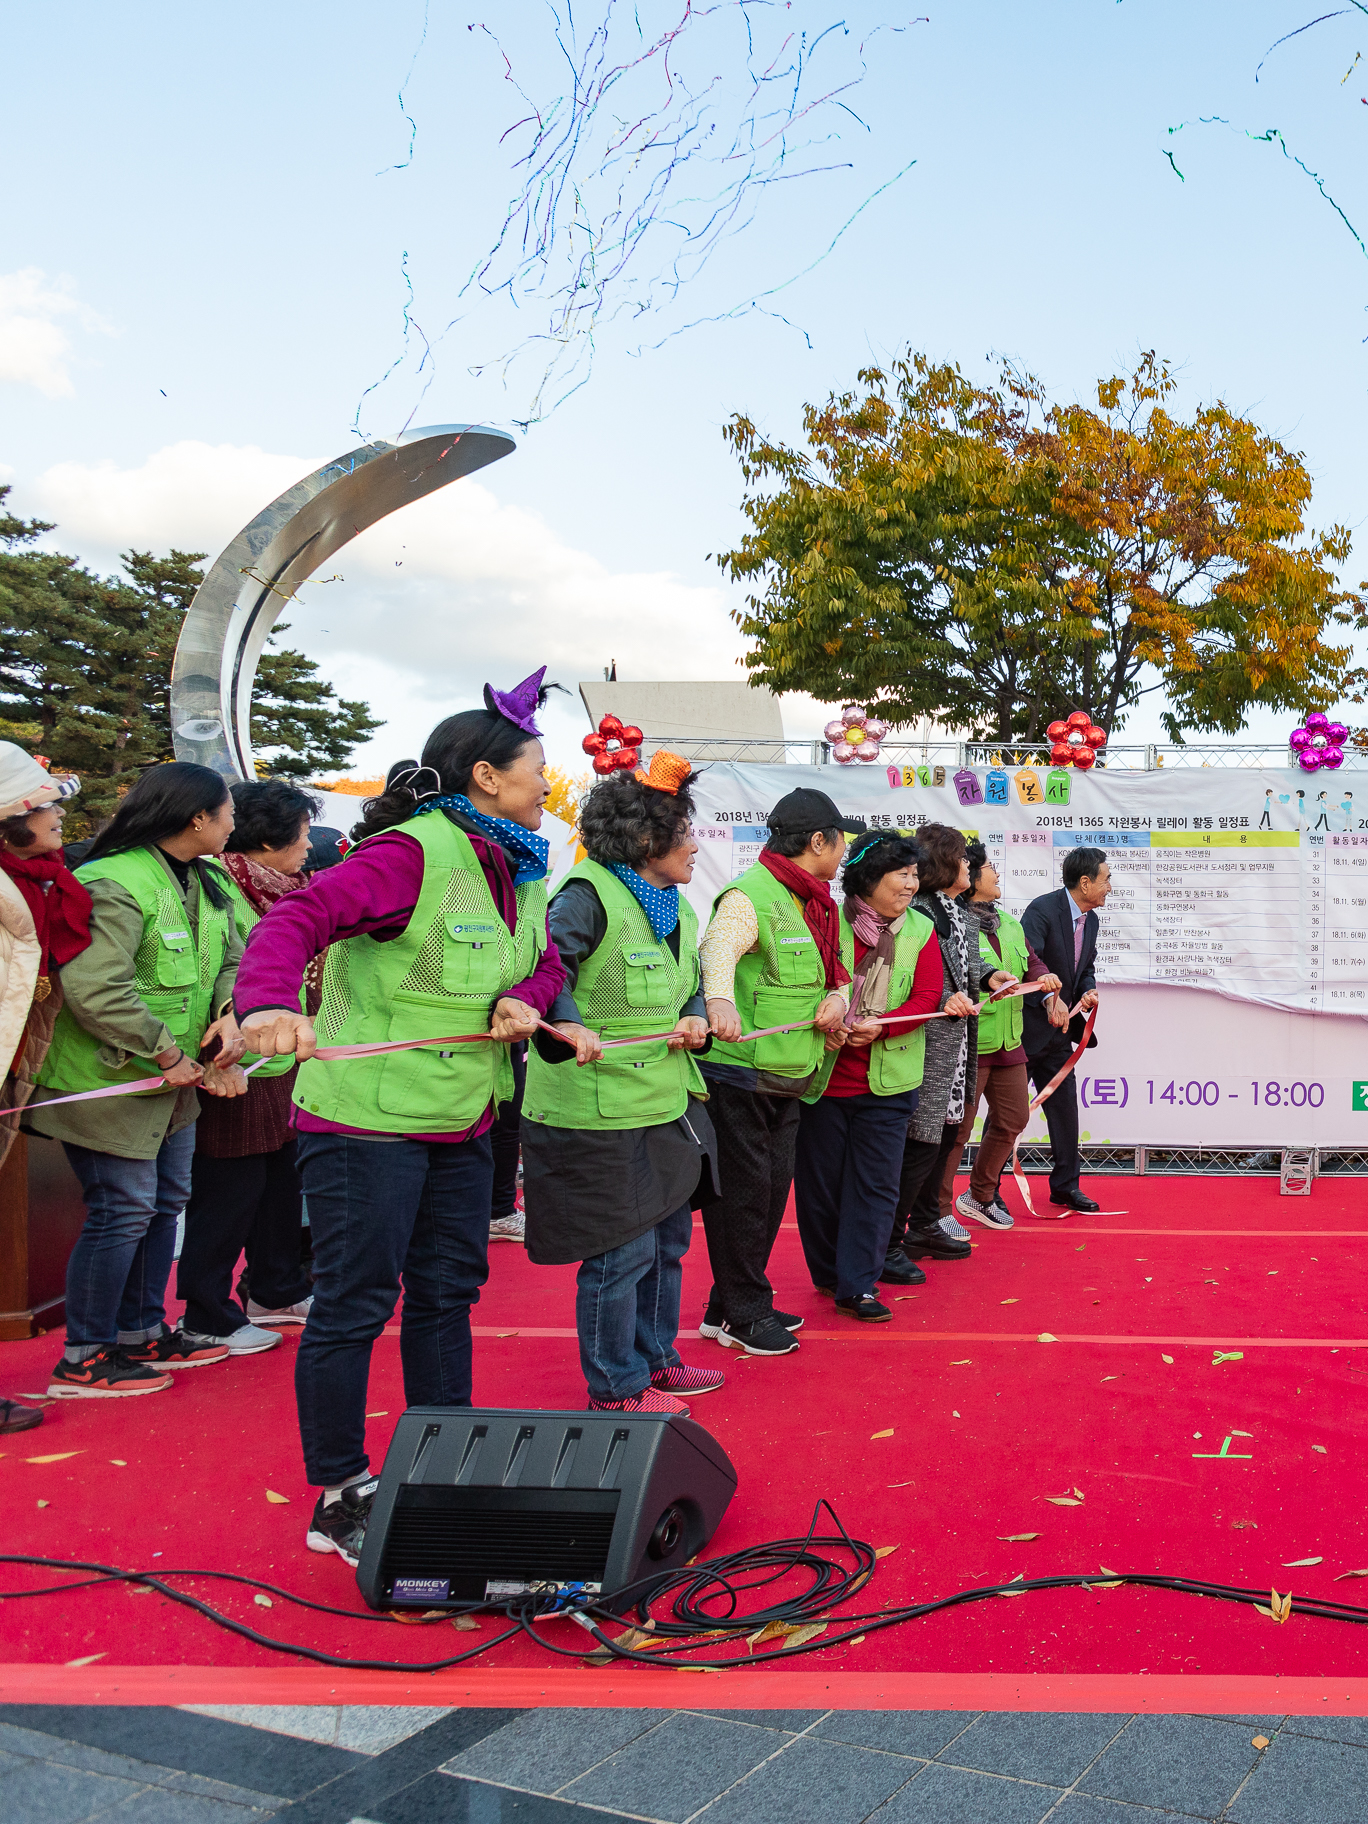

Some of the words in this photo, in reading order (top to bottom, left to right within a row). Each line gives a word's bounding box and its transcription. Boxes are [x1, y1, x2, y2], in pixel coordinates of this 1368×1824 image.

[715, 811, 752, 823] 2018년
[871, 815, 891, 827] 활동
[1036, 816, 1073, 828] 2018년
[1079, 816, 1104, 827] 1365
[1109, 816, 1152, 829] 자원봉사
[1157, 816, 1187, 829] 릴레이
[1193, 816, 1213, 829] 활동
[1219, 816, 1249, 828] 일정표
[989, 834, 1003, 843] 연번
[1309, 835, 1324, 845] 연번
[1012, 869, 1047, 877] 18.10.27(토)
[1311, 944, 1319, 952] 38
[1080, 1076, 1129, 1108] (토)
[1146, 1080, 1219, 1106] 14:00
[1250, 1081, 1325, 1108] 18:00
